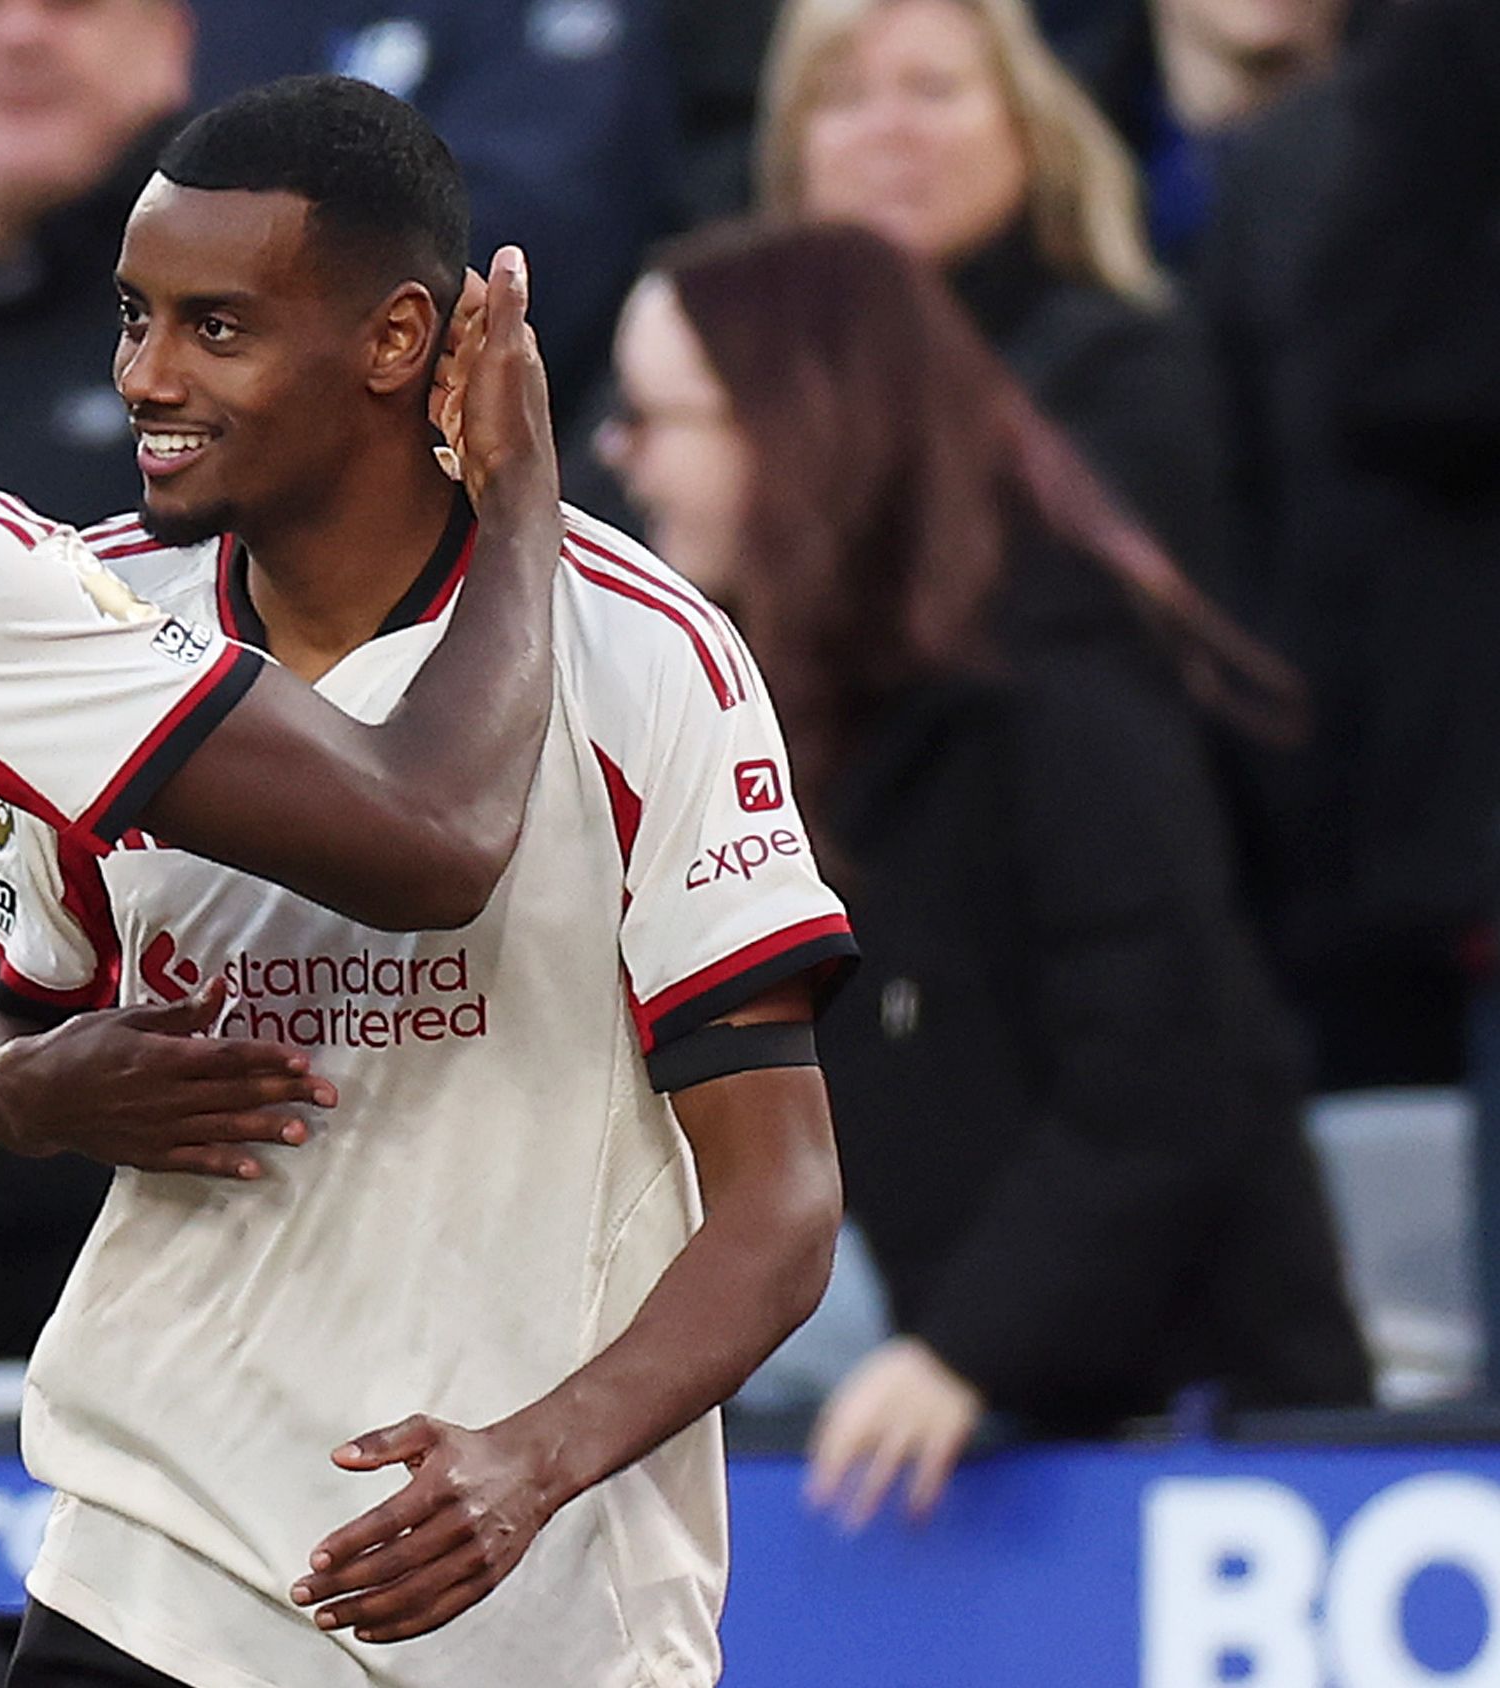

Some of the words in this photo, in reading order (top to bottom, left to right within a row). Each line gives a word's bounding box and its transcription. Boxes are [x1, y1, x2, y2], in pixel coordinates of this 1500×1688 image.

[223, 948, 467, 998] standard
[221, 996, 486, 1048] chartered
[1141, 1471, 1500, 1688] BO
